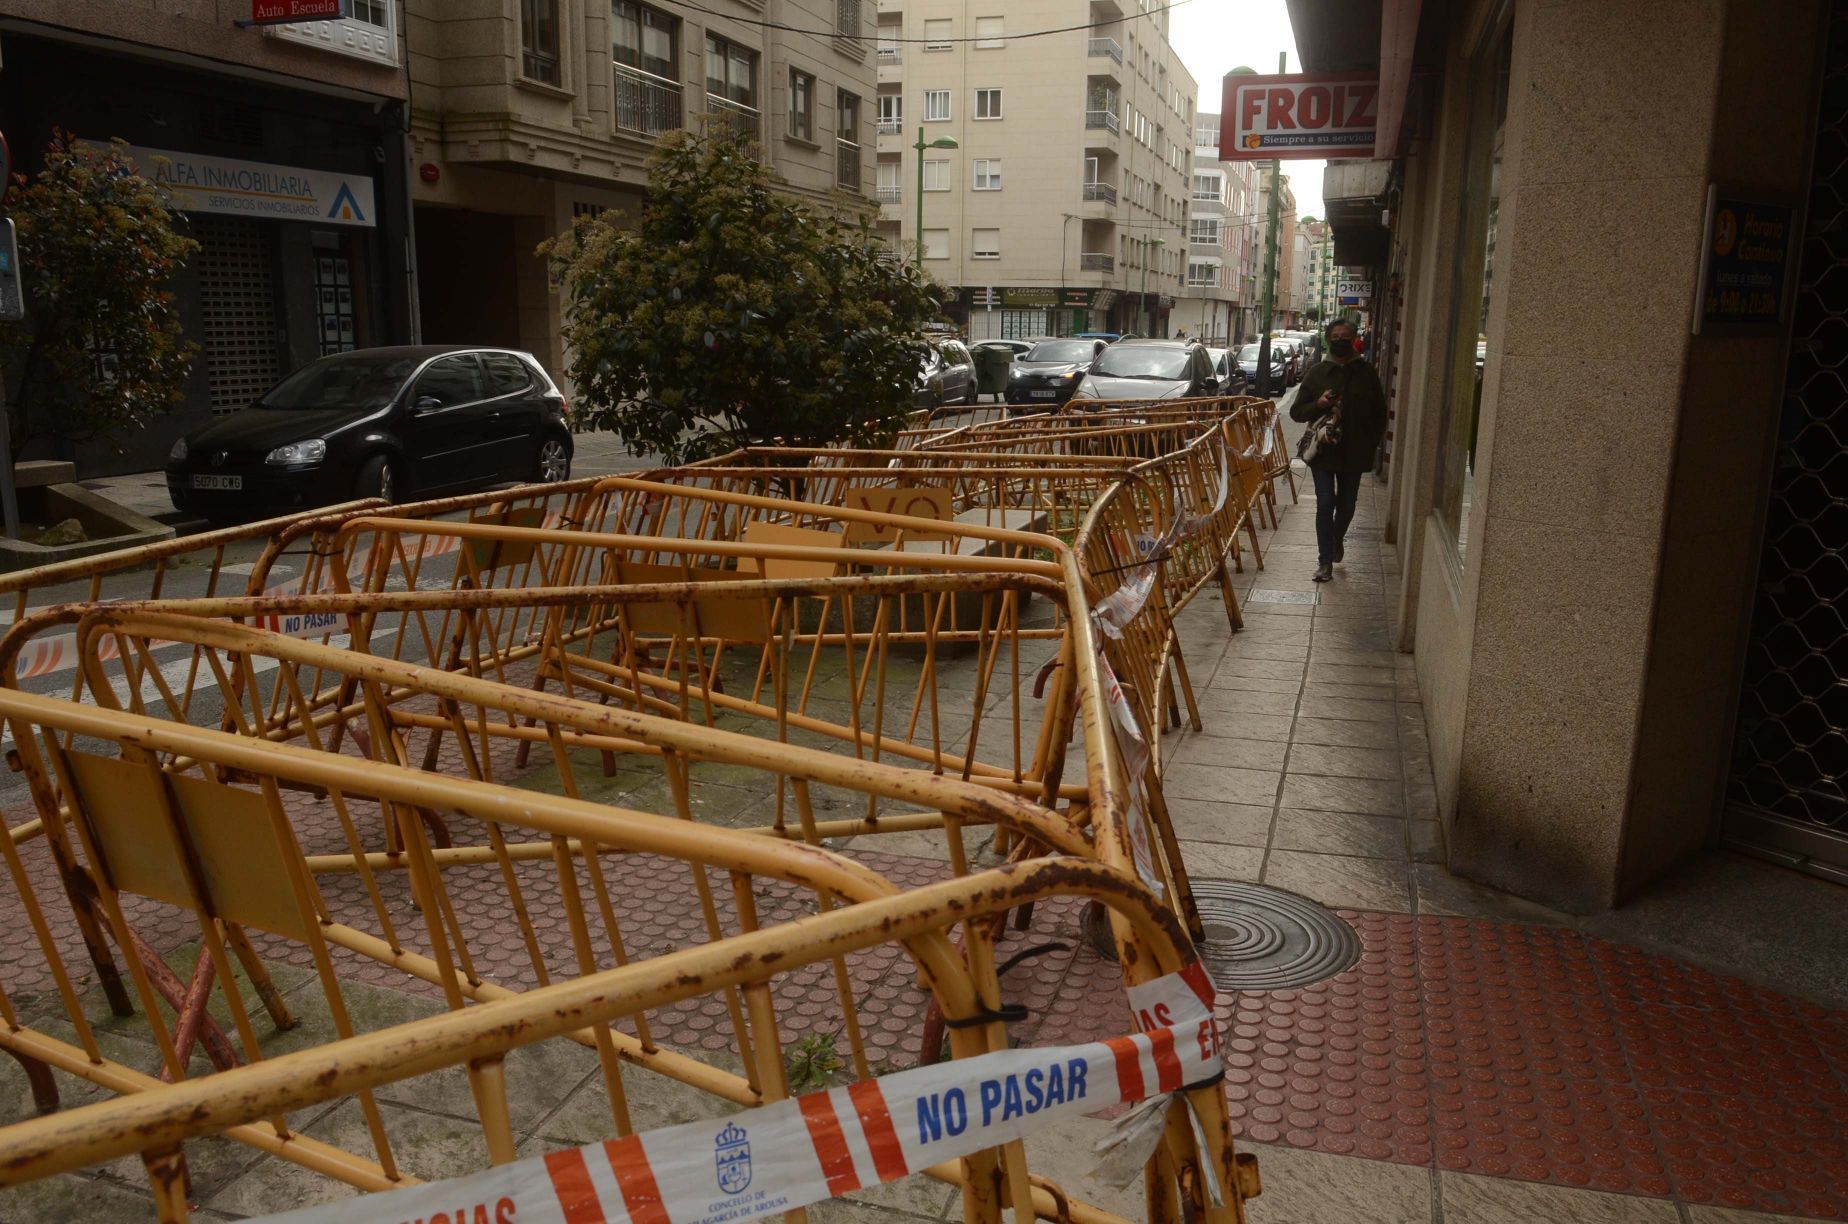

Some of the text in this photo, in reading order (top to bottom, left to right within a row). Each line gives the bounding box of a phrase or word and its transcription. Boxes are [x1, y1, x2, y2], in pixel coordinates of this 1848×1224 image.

[256, 0, 336, 17] Auto Escuela
[1242, 86, 1378, 130] FROIZ
[1263, 135, 1306, 145] Siempre
[1332, 134, 1374, 143] servicio
[156, 163, 313, 197] ALFA INMOBILIARIA
[208, 195, 321, 216] SERVICIOS INMOBILIARIOS
[285, 612, 337, 633] NO PASAR
[915, 1057, 1088, 1145] NO PASAR
[708, 1190, 765, 1213] CONCELLO DE
[740, 1206, 752, 1215] DE
[755, 1196, 788, 1212] AROUSA
